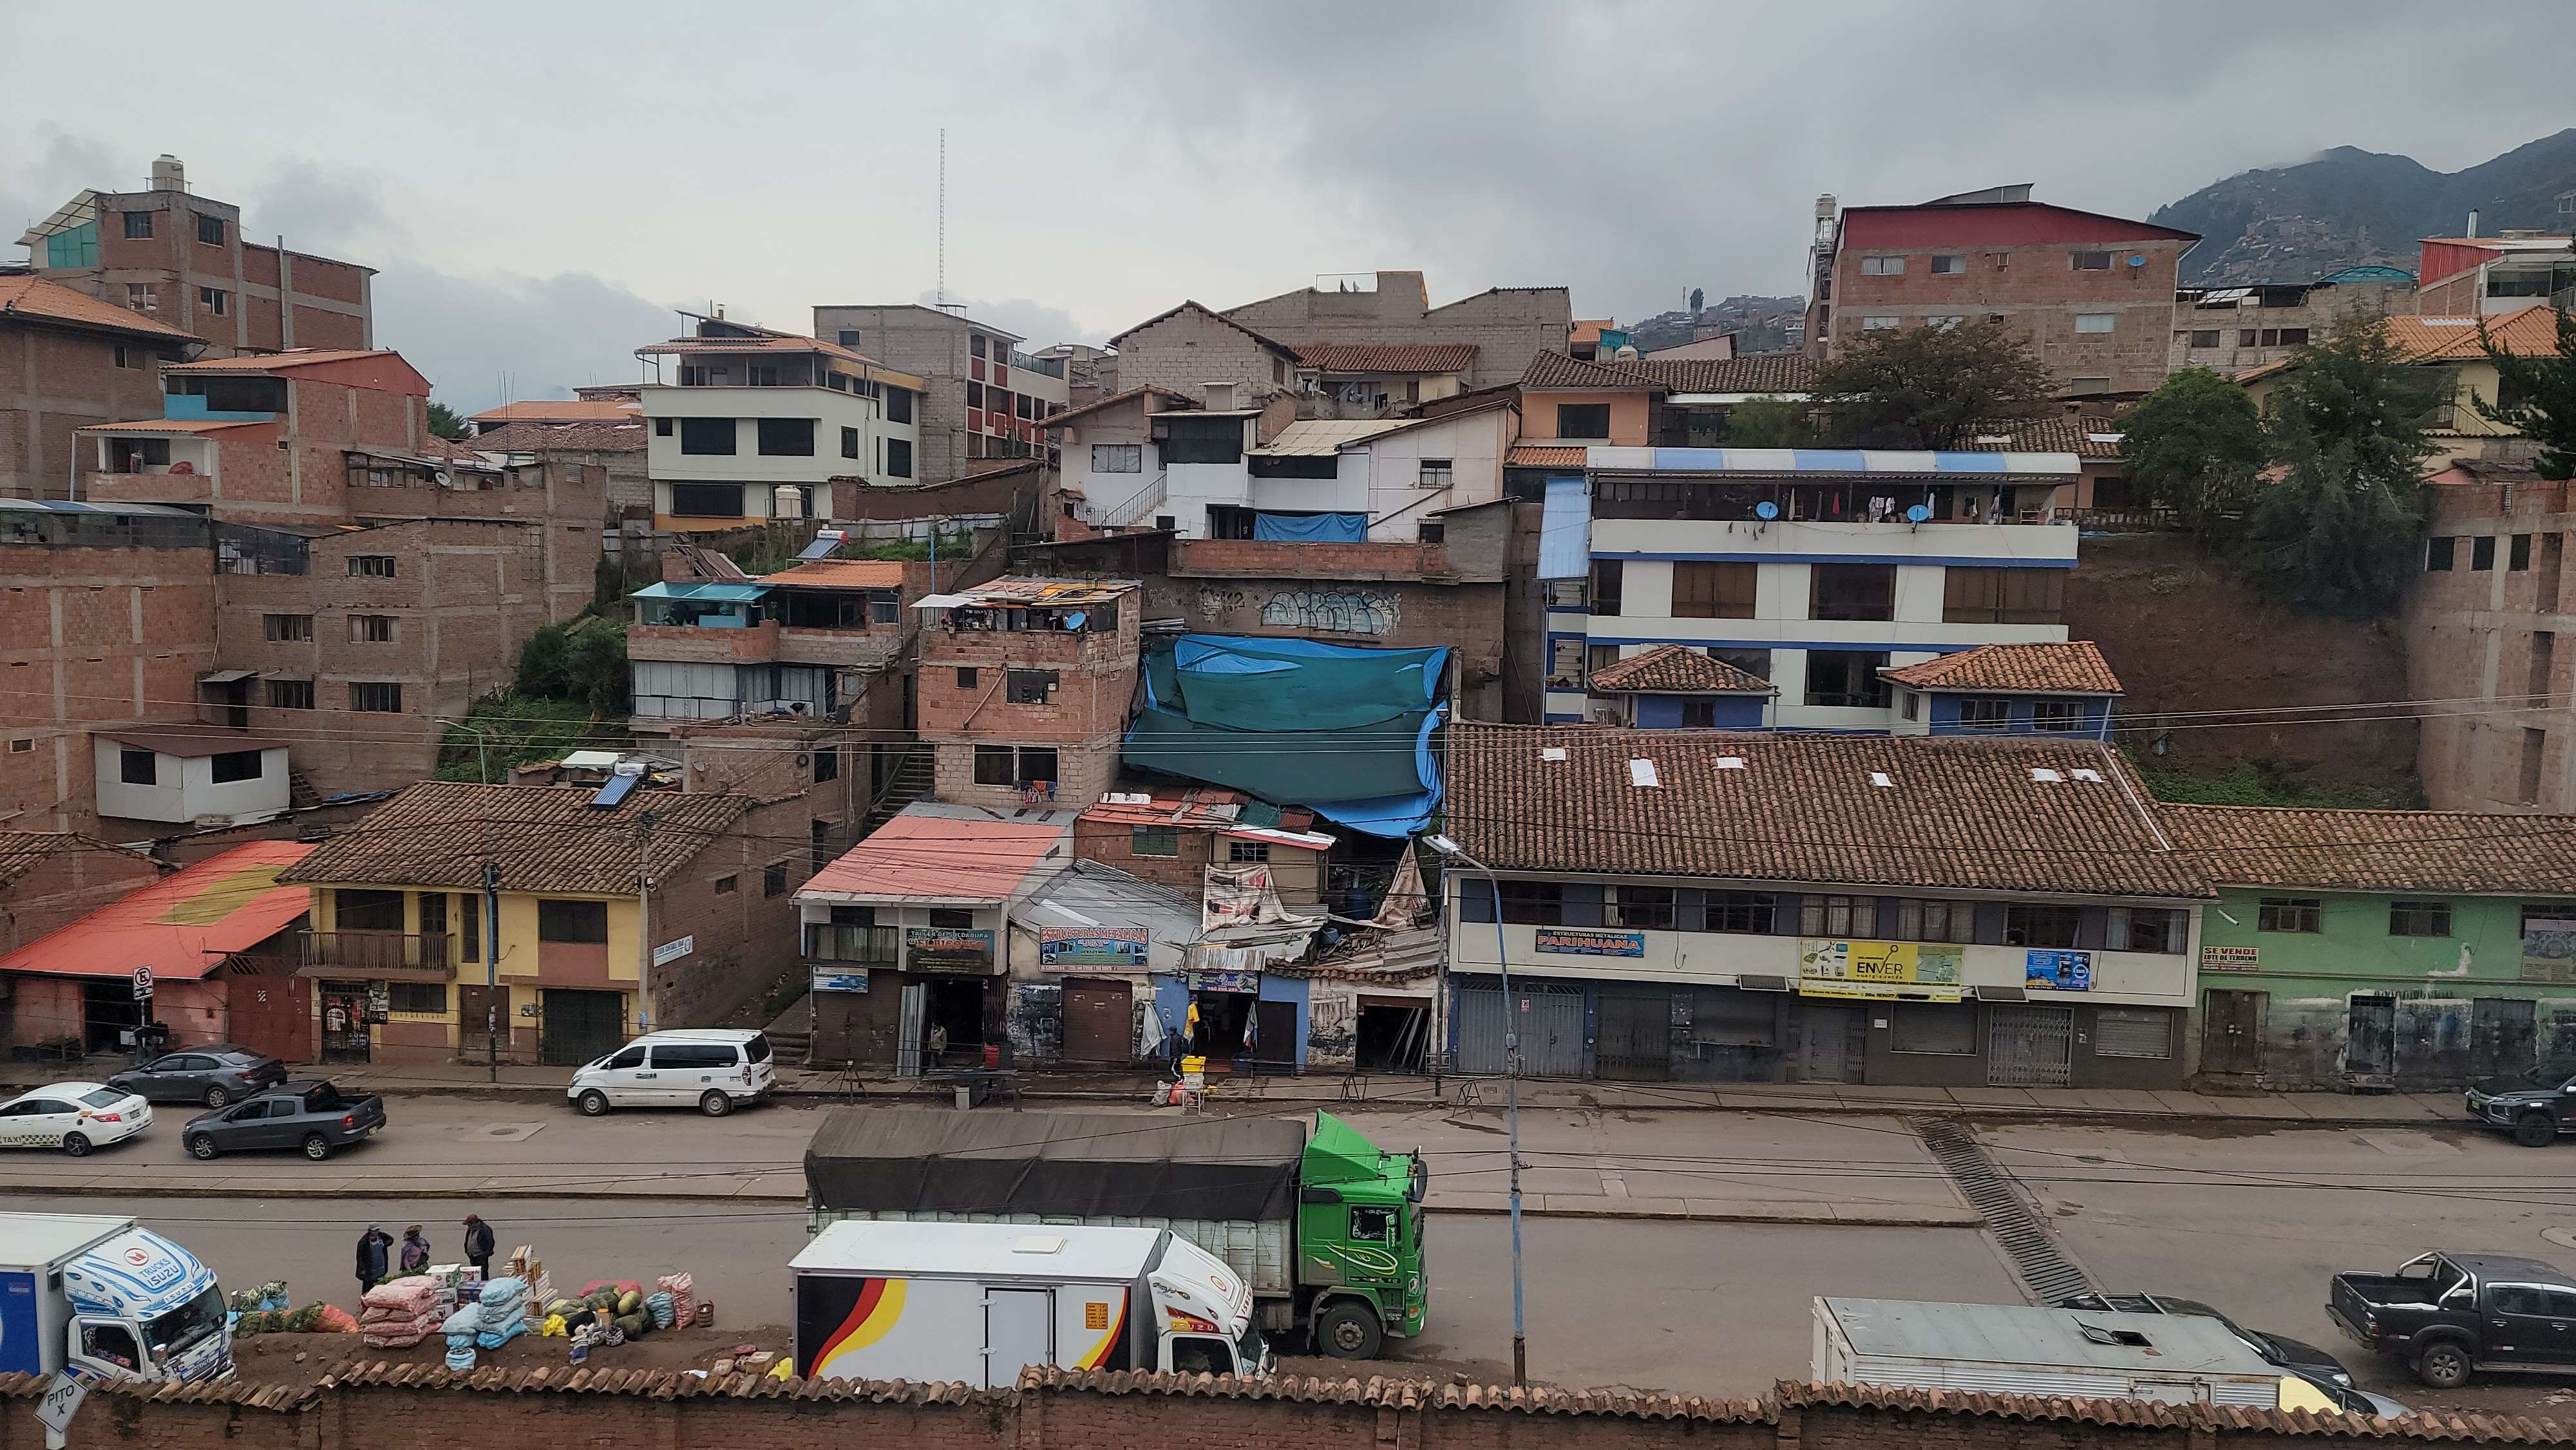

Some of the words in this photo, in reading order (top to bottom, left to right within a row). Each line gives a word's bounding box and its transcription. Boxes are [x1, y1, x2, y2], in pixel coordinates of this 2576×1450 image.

[1041, 928, 1100, 943] ESTRUCTURAS
[1537, 936, 1639, 950] PARIHUANA
[1857, 959, 1903, 975] ENVER
[138, 1258, 171, 1277] TRUCKS
[147, 1265, 179, 1287] ISUZU
[166, 1284, 193, 1301] ISUZU
[1172, 1323, 1213, 1332] ISUZU
[48, 1384, 74, 1407] PITO
[57, 1402, 65, 1417] X
